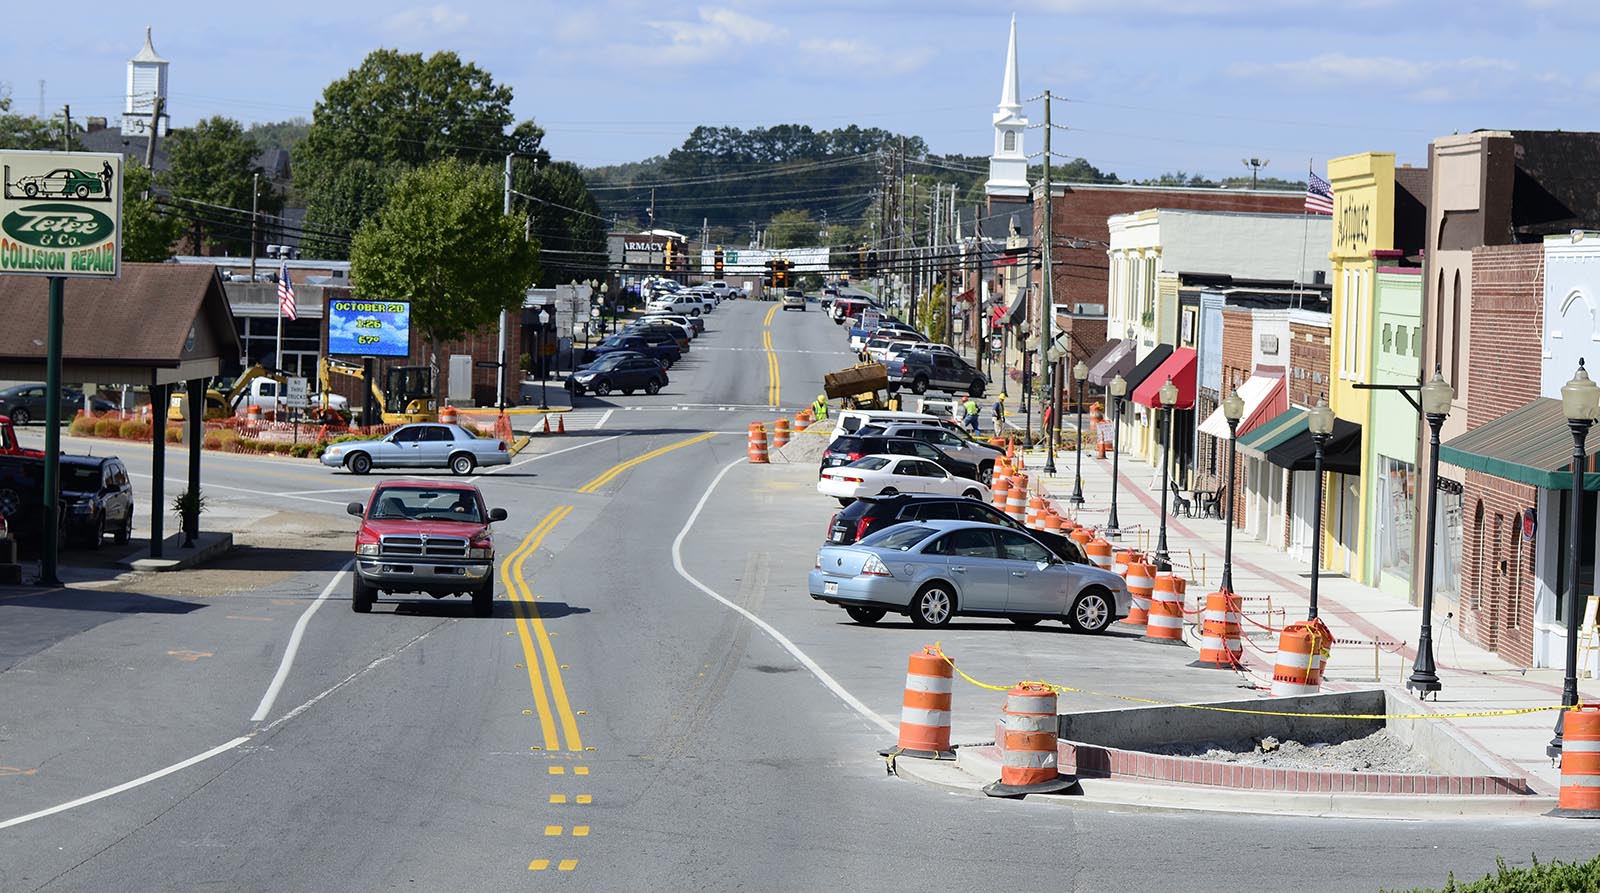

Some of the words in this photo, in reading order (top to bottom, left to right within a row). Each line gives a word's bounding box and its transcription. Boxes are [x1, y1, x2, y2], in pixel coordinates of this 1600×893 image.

[1337, 194, 1369, 250] Antiques
[40, 234, 53, 245] &
[58, 234, 80, 246] Co.
[1, 238, 65, 270] COLLISION
[71, 242, 114, 272] REPAIR
[335, 302, 386, 312] OCTOBER
[388, 304, 404, 312] 20
[356, 319, 382, 328] 1:26
